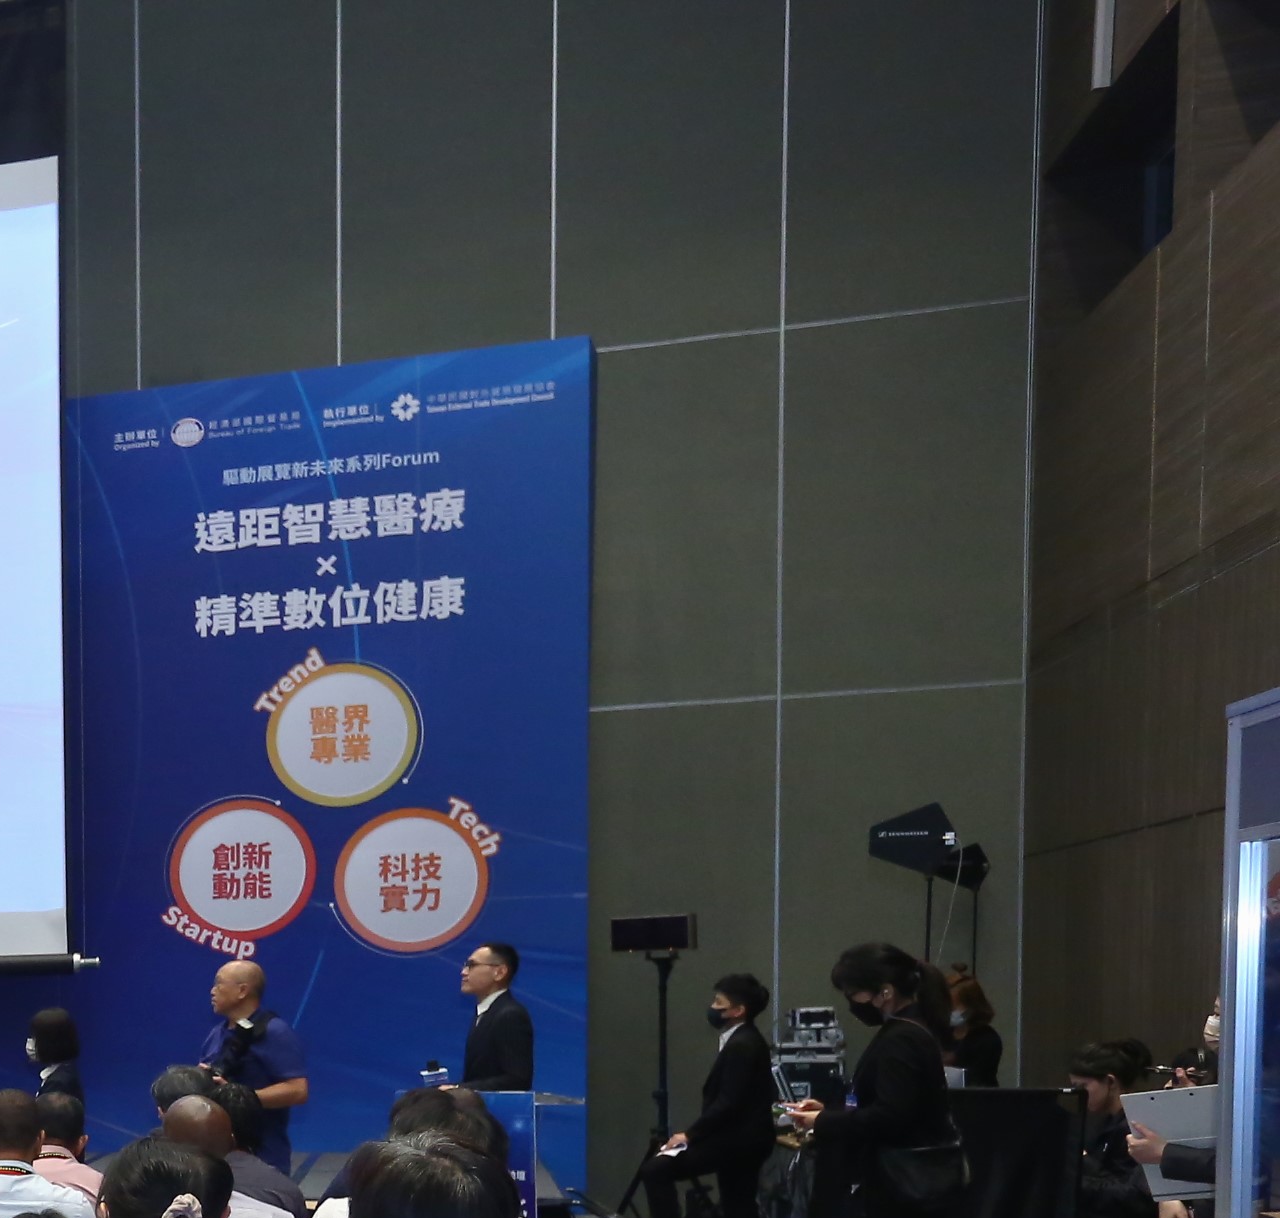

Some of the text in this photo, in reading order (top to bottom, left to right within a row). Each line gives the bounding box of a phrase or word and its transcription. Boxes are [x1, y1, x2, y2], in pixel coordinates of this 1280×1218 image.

[222, 451, 440, 486] 驅動展覽新未來系列Forum
[193, 487, 465, 554] 遠距智慧醫療
[194, 576, 465, 638] 精準數位健康
[254, 647, 327, 717] Trend
[309, 704, 371, 735] 醫界
[309, 733, 371, 764] 專業
[447, 797, 502, 859] Tech
[212, 842, 272, 872] 創新
[379, 853, 442, 884] 科技
[212, 871, 272, 901] 動能
[379, 882, 441, 913] 實力
[161, 905, 256, 960] Startup
